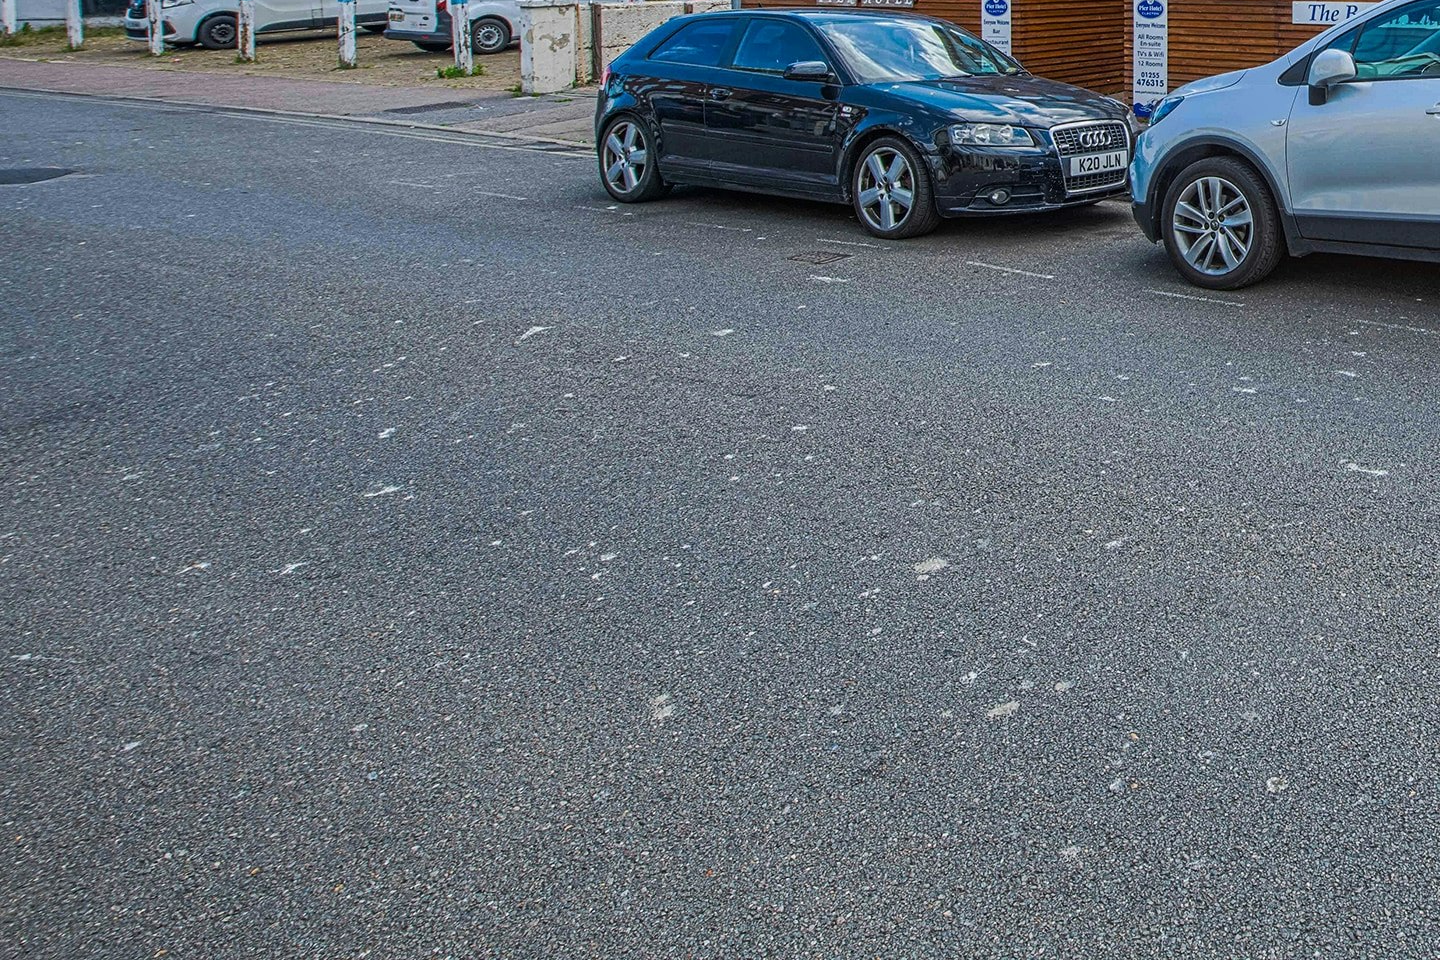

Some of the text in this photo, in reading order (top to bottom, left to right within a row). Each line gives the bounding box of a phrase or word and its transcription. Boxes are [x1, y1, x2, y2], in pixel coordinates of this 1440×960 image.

[1308, 4, 1340, 22] The
[1136, 79, 1164, 87] 476315
[1079, 153, 1121, 172] K20 JLN
